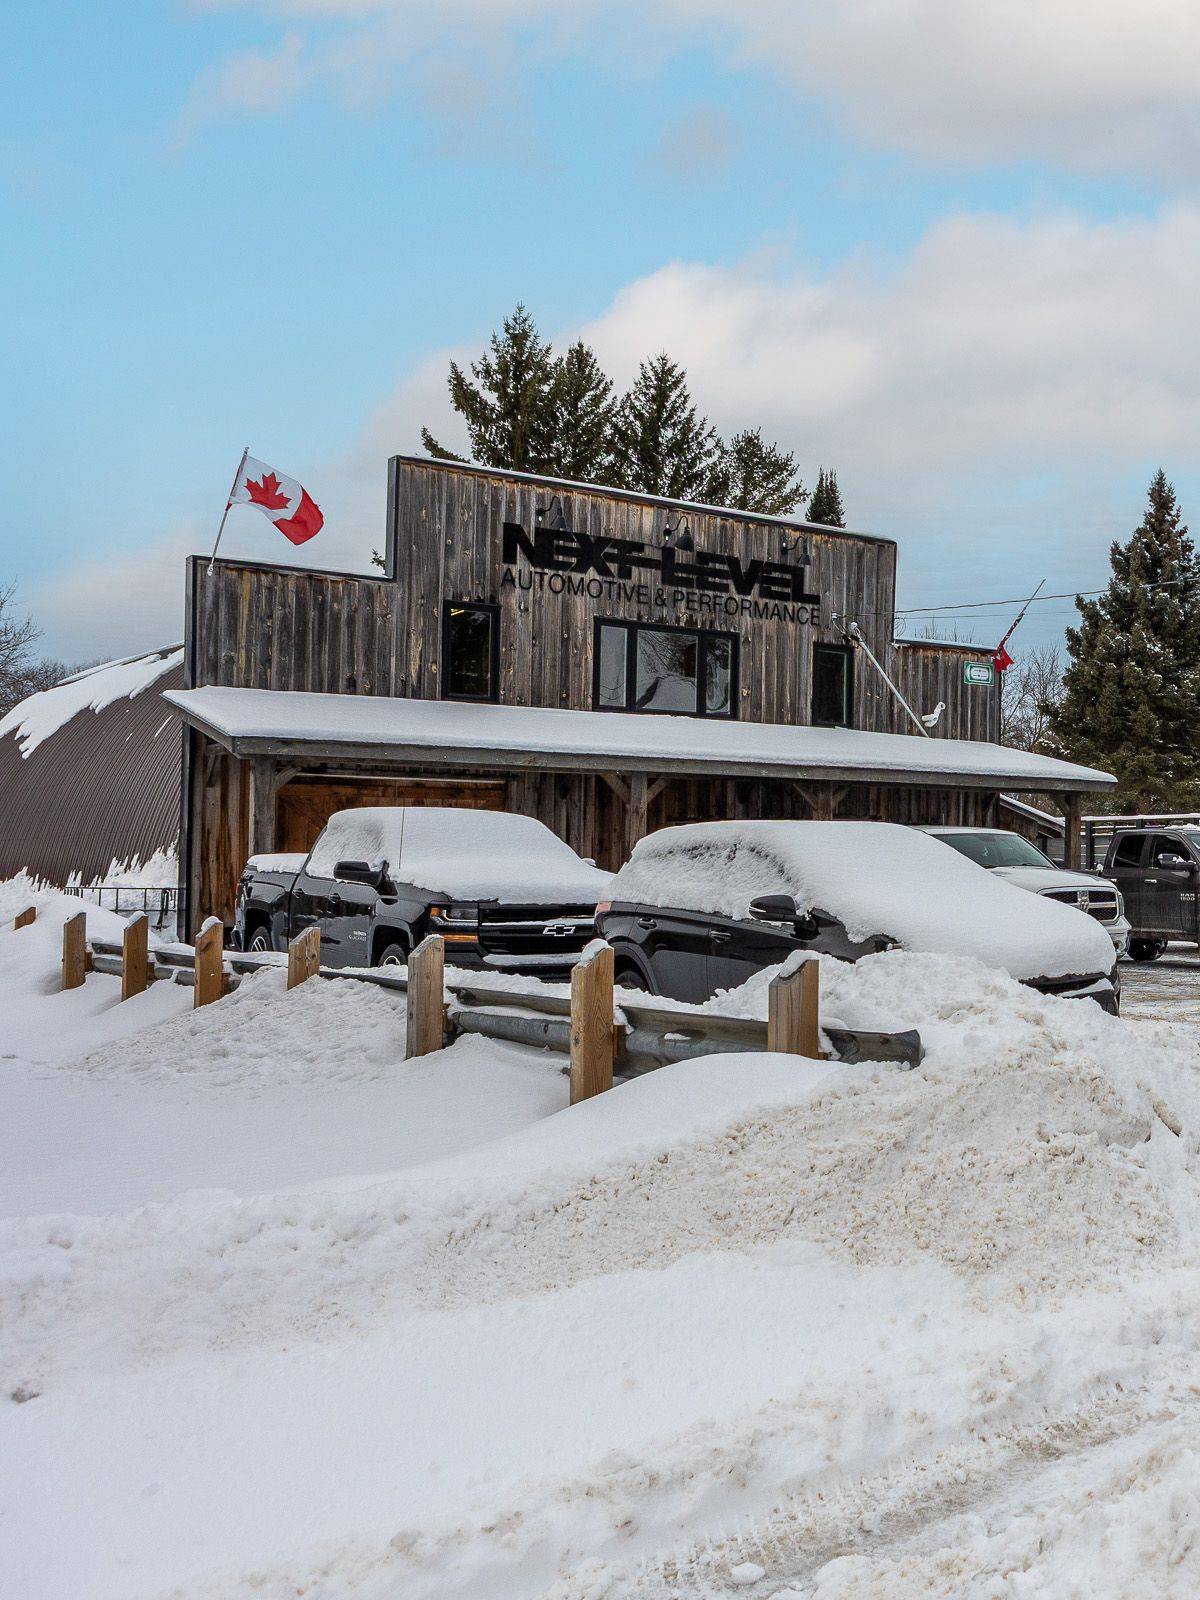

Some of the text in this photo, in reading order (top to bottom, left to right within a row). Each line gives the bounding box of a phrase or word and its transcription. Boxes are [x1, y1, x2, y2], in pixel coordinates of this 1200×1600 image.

[500, 567, 821, 627] AUTOMOTIVE & PERFORMANCE
